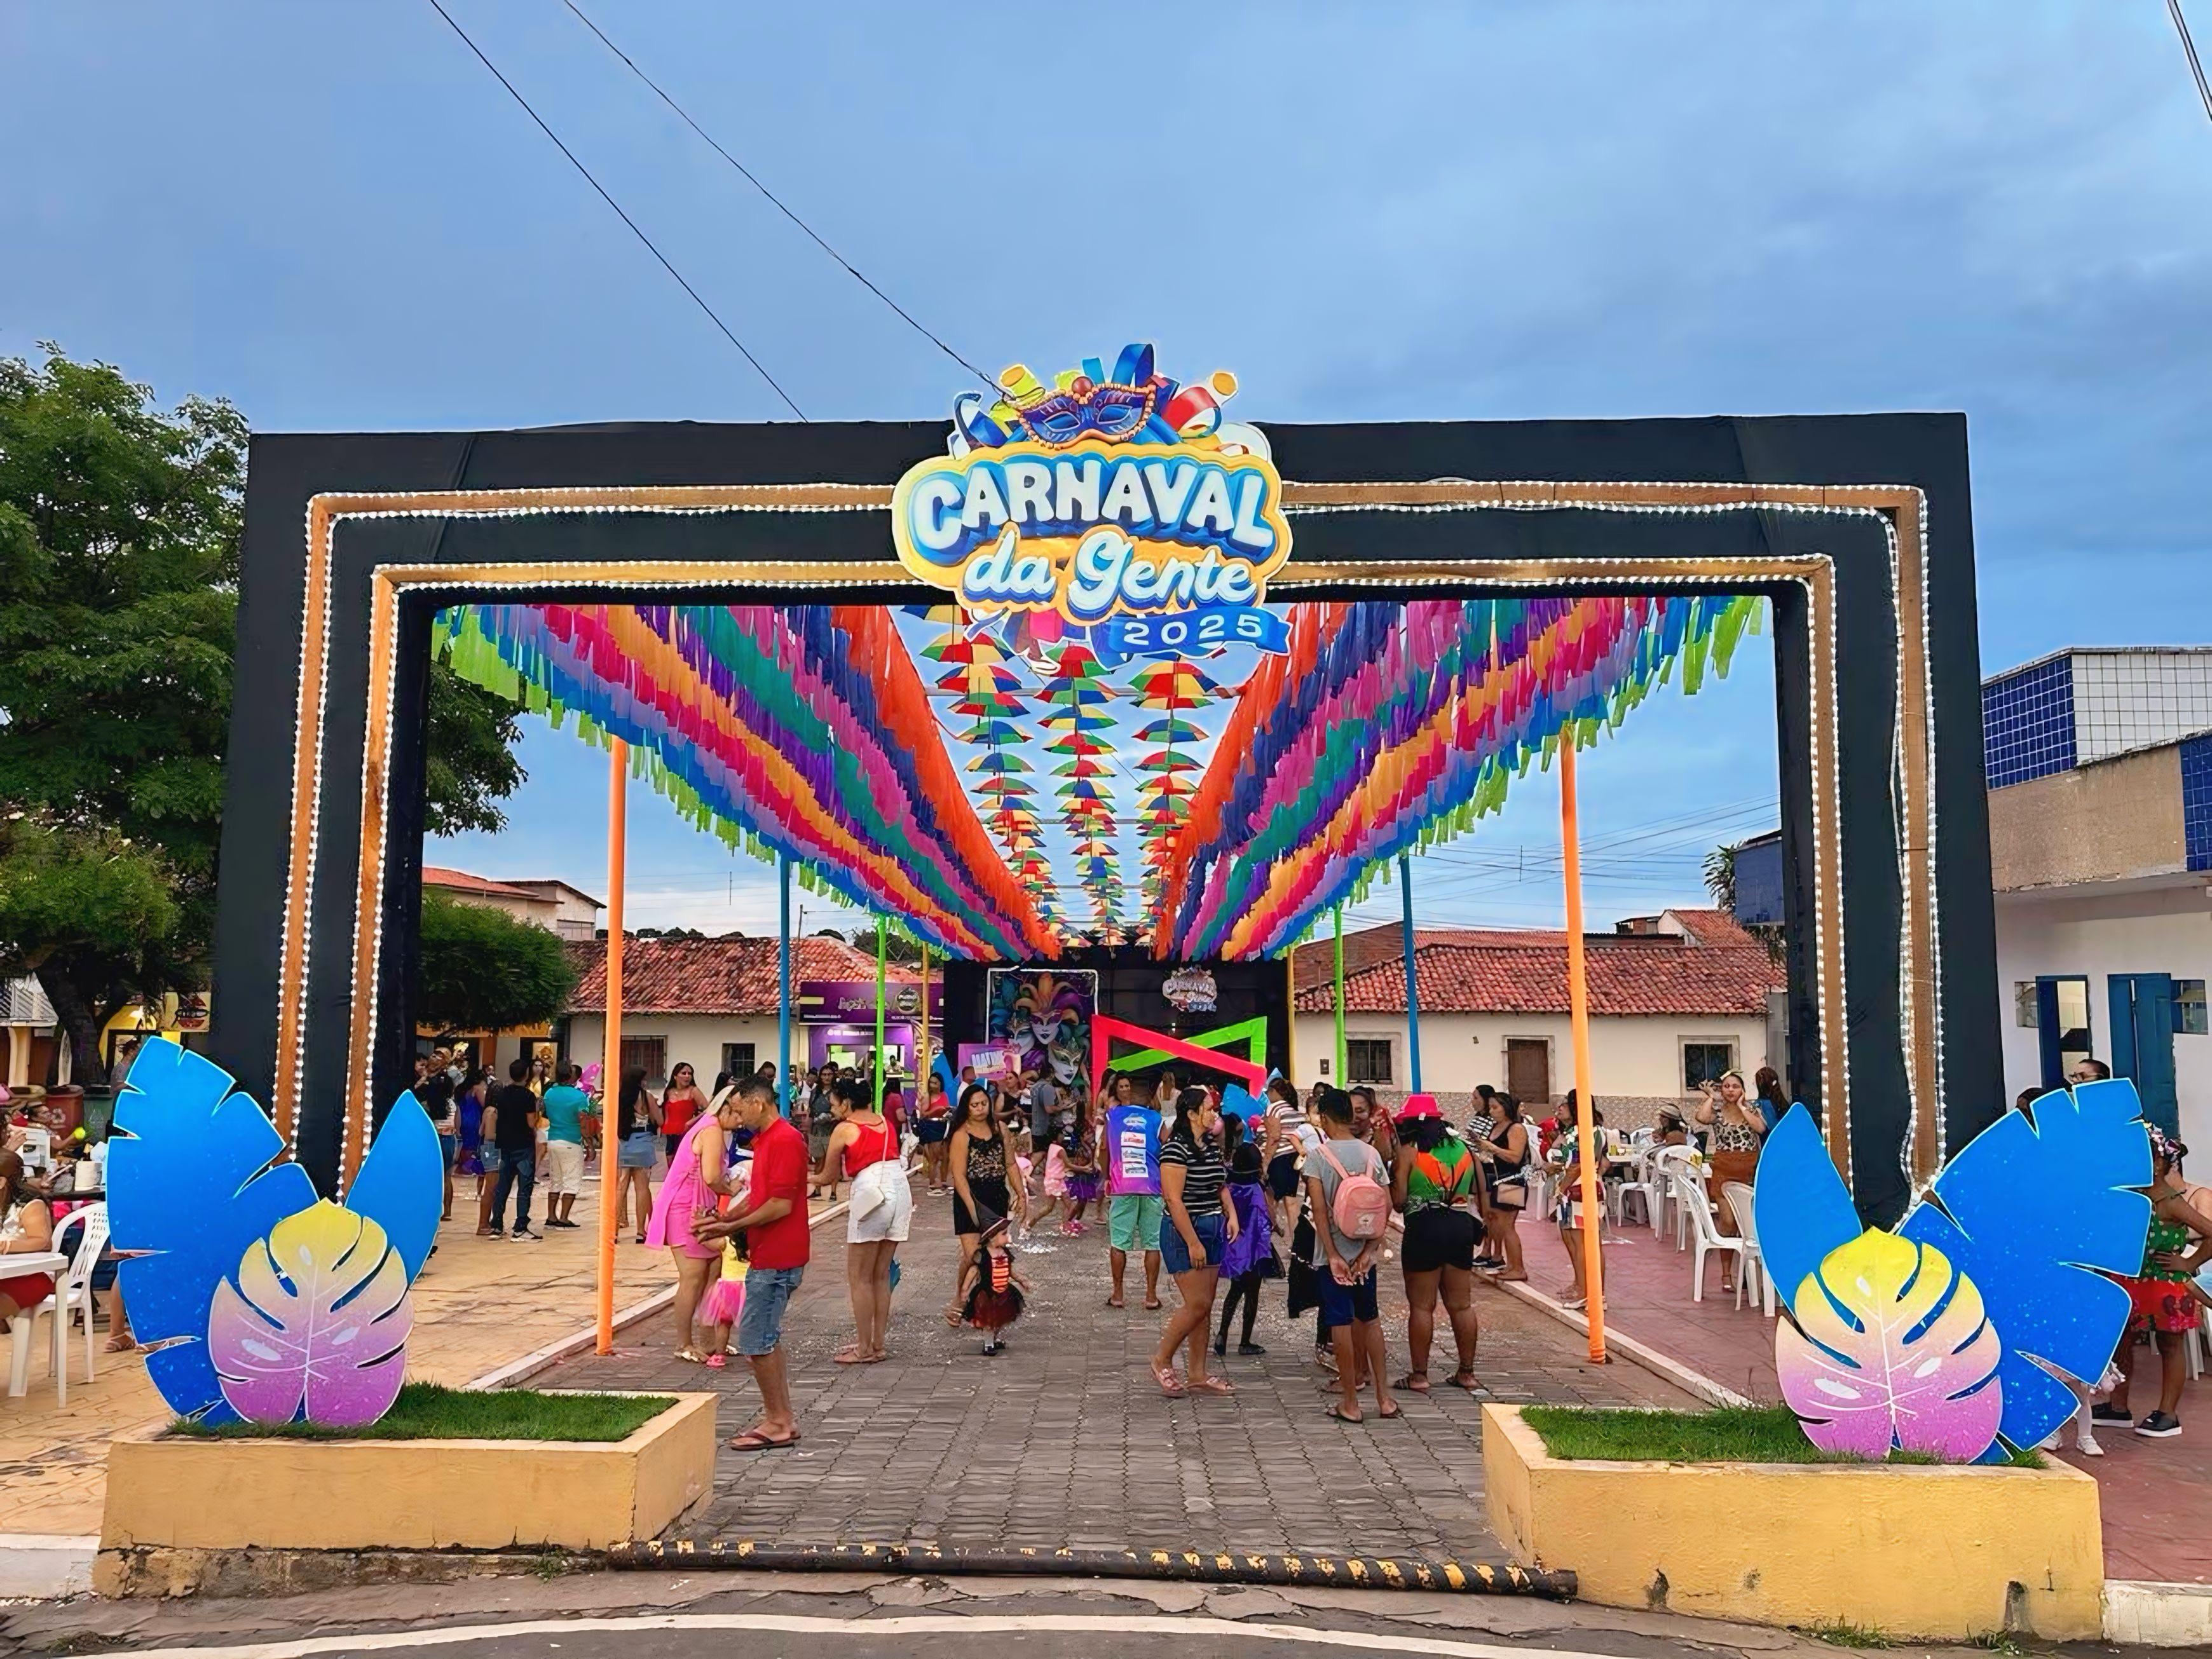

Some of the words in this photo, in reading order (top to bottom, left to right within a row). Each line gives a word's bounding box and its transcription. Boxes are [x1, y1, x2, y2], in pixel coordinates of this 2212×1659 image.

[913, 459, 1274, 550] CARNAVAL
[962, 528, 1057, 604] da
[1123, 613, 1264, 647] 2025
